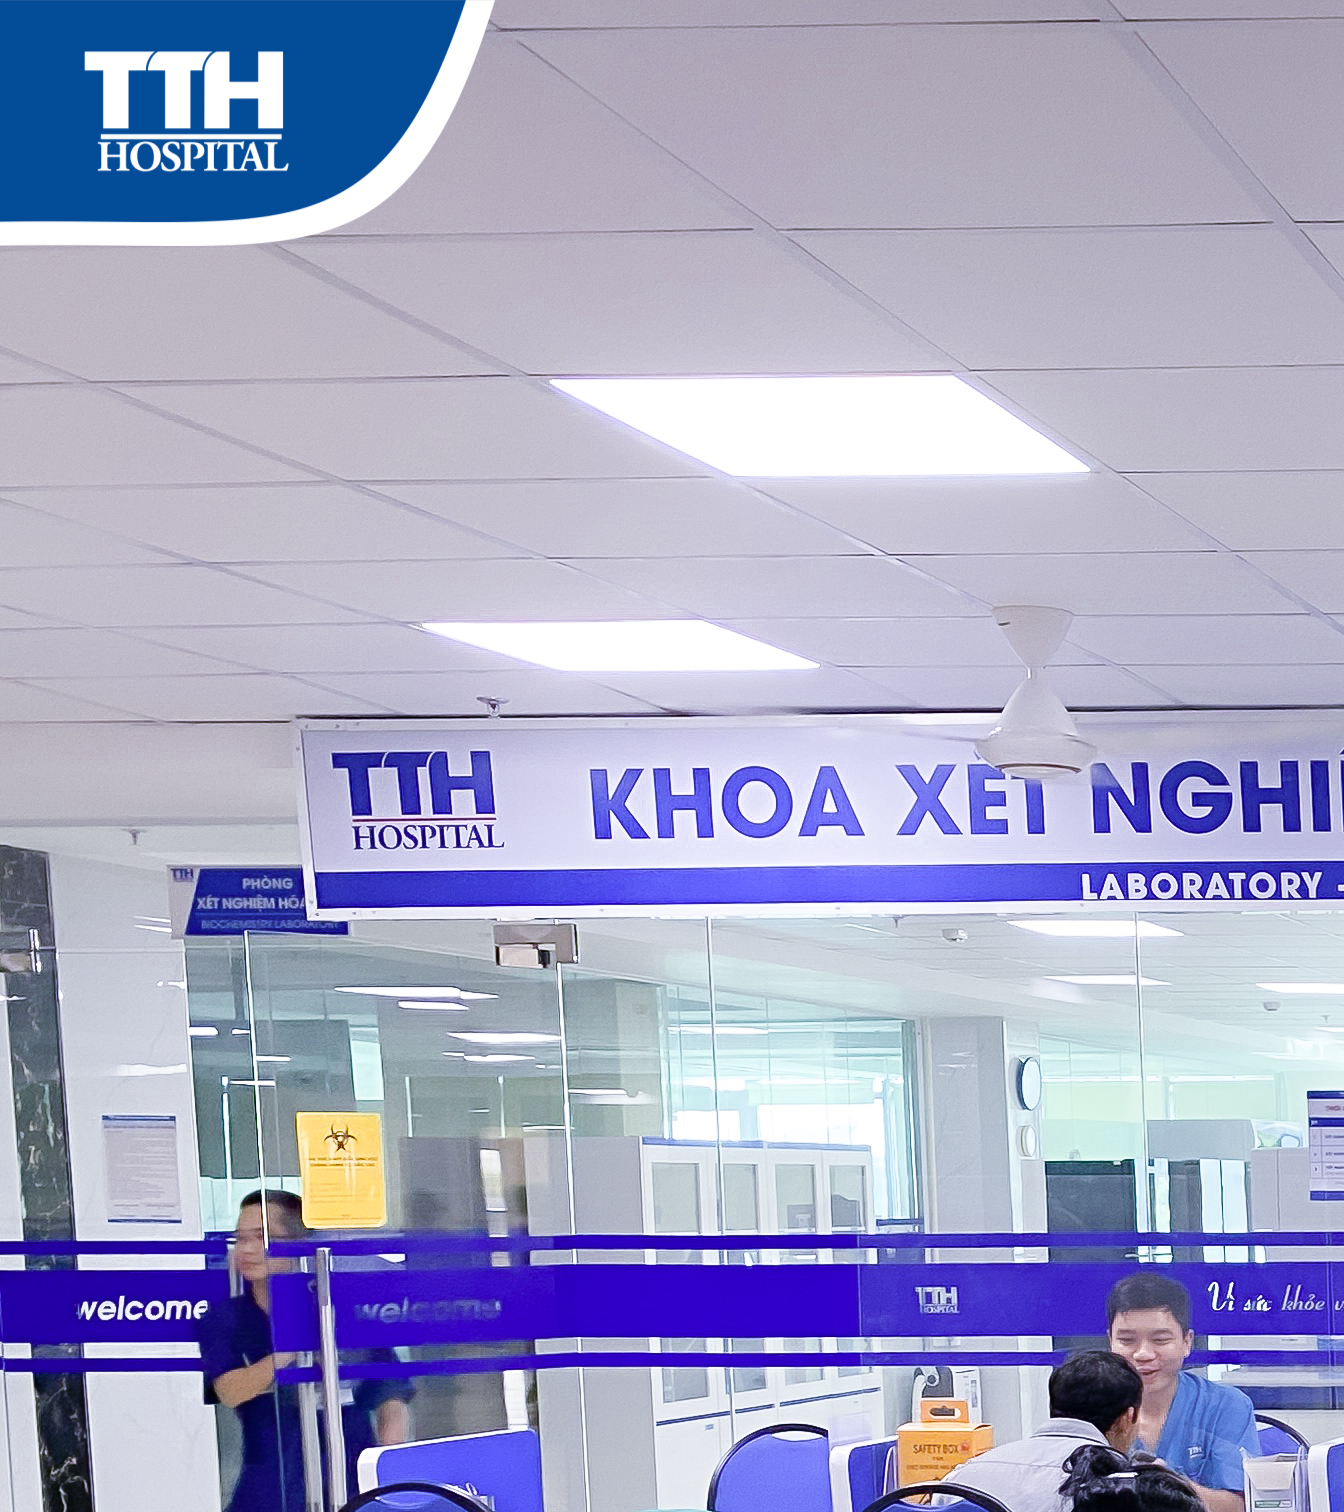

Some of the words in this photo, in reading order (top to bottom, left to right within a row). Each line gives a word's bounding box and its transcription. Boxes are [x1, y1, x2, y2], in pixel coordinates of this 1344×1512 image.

[331, 750, 497, 816] TTH
[589, 765, 866, 840] KHOA
[352, 823, 505, 850] HOSPITAL
[242, 875, 293, 890] PHÒNG
[1080, 871, 1323, 901] LABORATORY
[76, 1295, 208, 1321] welcome
[914, 1286, 958, 1304] TTH
[1280, 1283, 1326, 1312] khỏe
[913, 1443, 941, 1455] SAFETY
[942, 1444, 960, 1455] BOX
